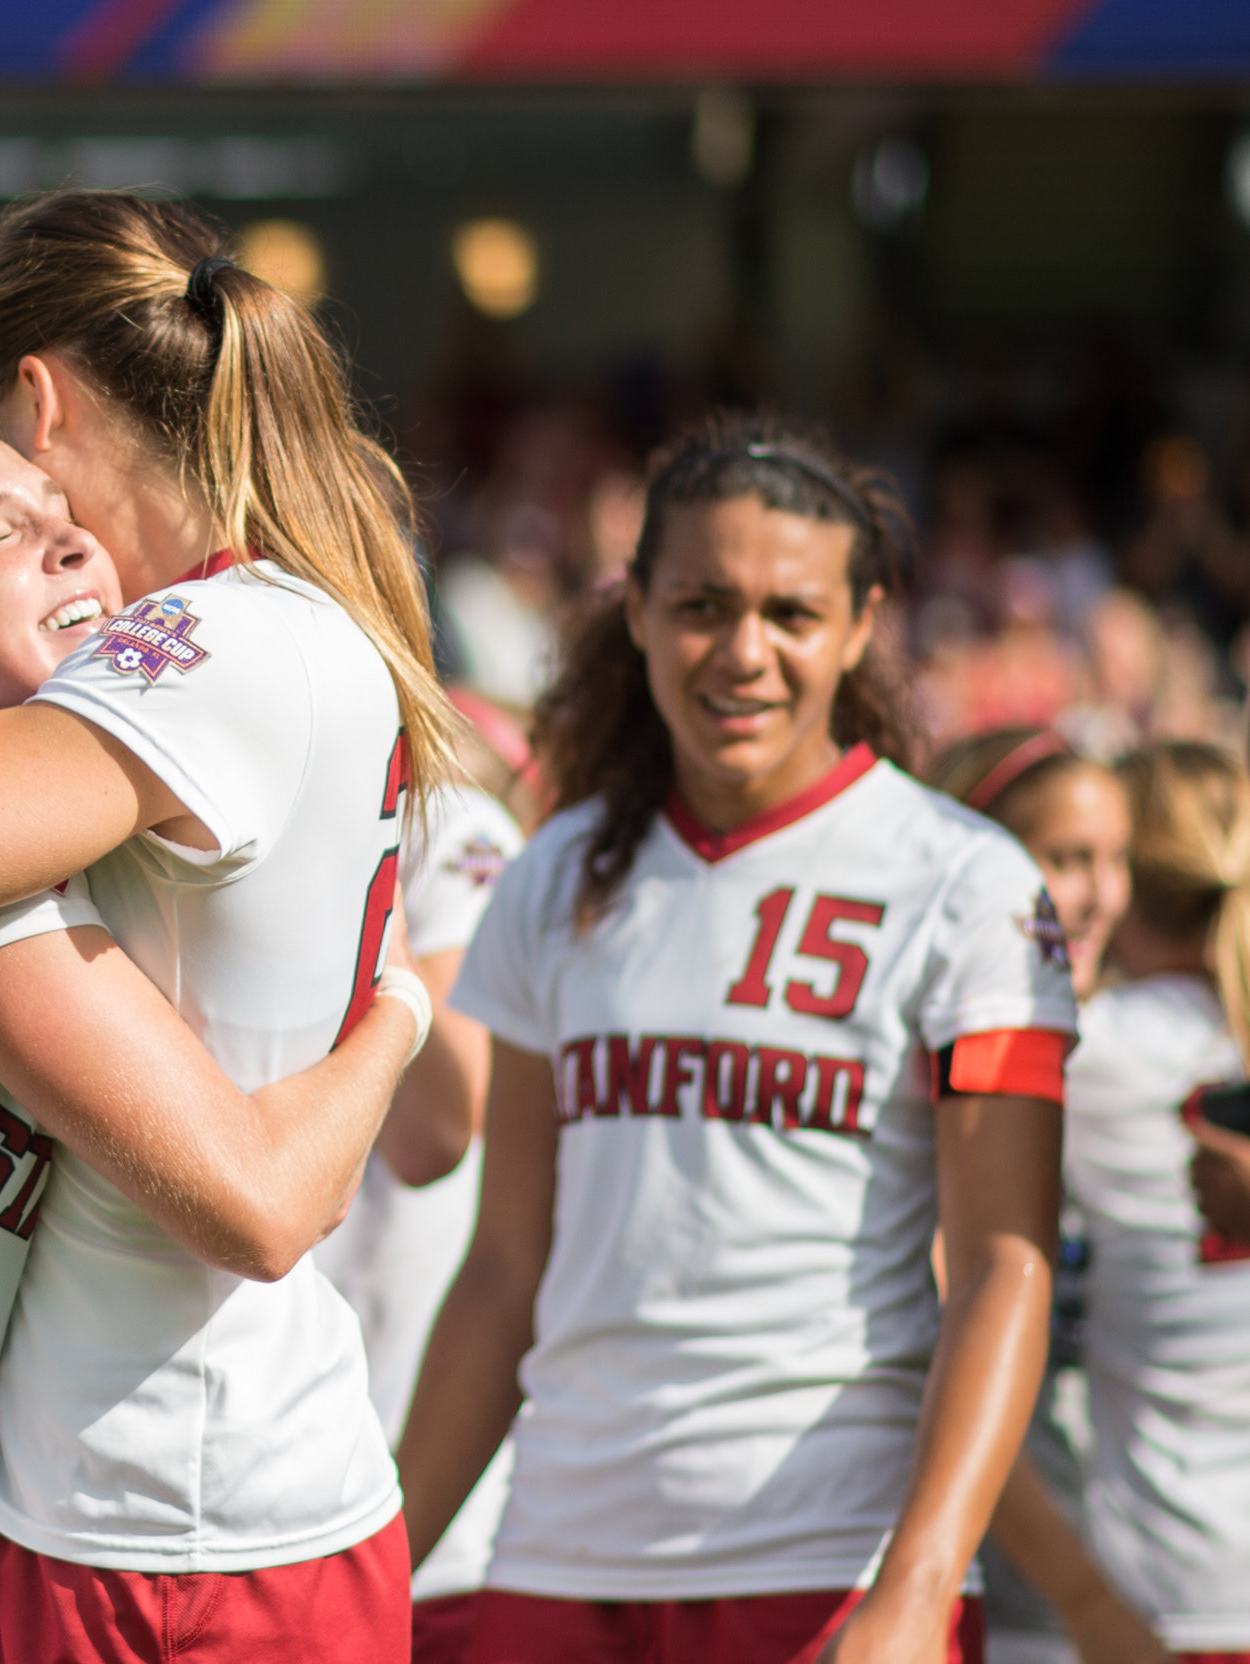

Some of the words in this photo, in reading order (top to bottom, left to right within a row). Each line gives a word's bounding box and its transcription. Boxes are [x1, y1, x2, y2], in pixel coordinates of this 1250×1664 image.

[109, 619, 169, 646] COLLEGE
[161, 637, 196, 661] CUP
[724, 885, 887, 1023] 15
